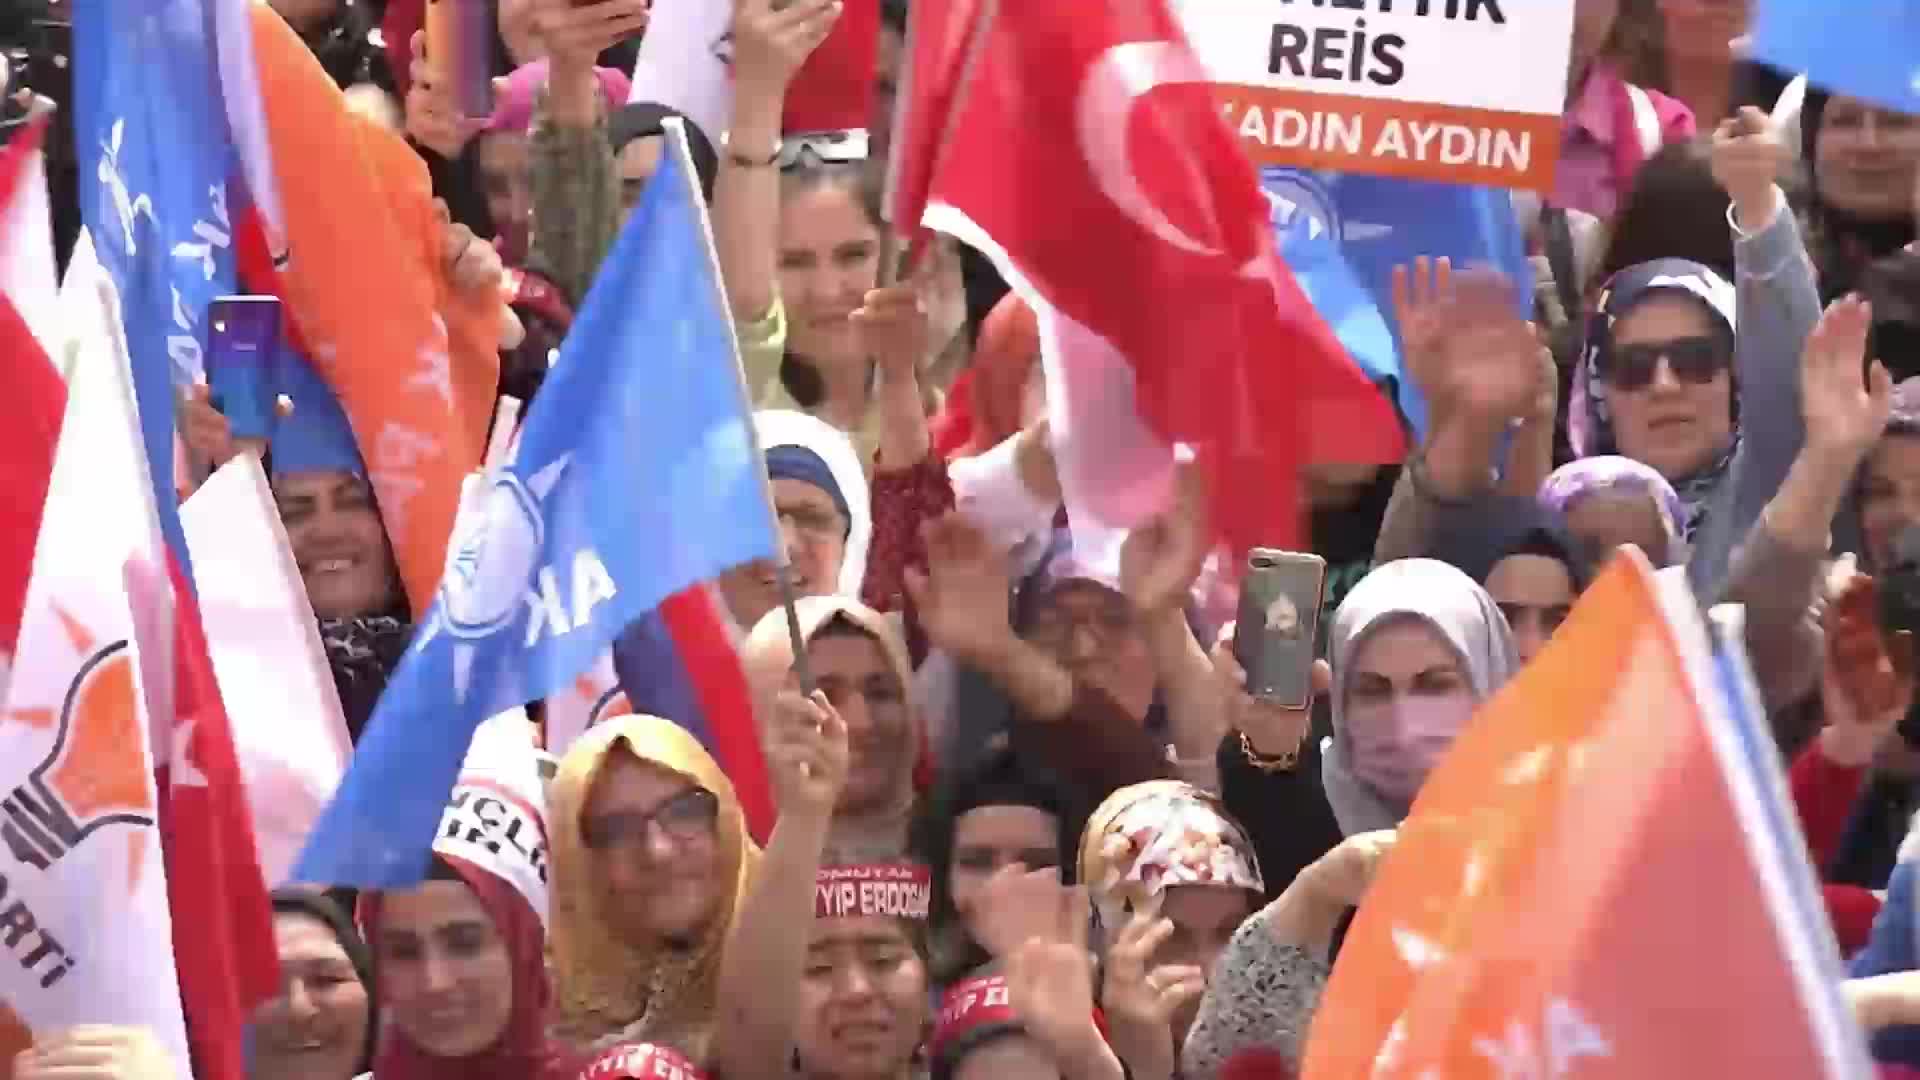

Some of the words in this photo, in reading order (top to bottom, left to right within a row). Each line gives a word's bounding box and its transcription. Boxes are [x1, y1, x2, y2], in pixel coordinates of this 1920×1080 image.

[1268, 16, 1406, 86] REİS
[1224, 103, 1363, 155] ADIN
[1371, 118, 1531, 172] AYDIN
